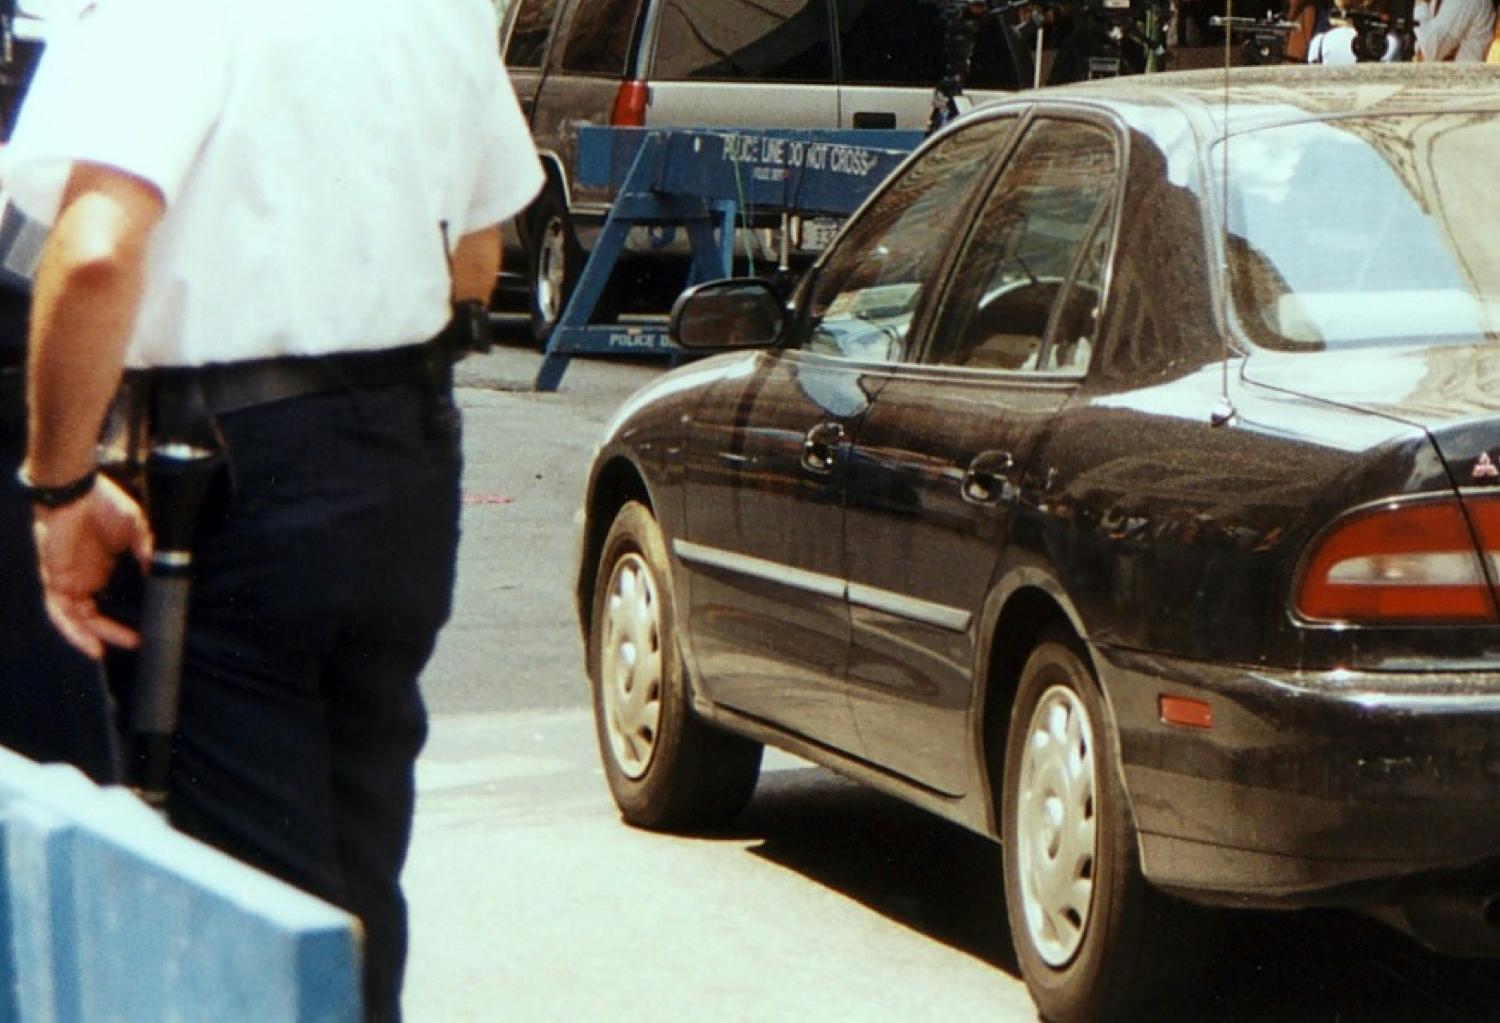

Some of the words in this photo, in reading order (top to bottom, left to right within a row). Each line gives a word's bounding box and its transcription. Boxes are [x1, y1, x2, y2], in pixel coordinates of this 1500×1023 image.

[722, 134, 758, 162] POLICE
[762, 137, 784, 164] LINE
[806, 143, 828, 170] NOT
[831, 146, 868, 176] CROSS
